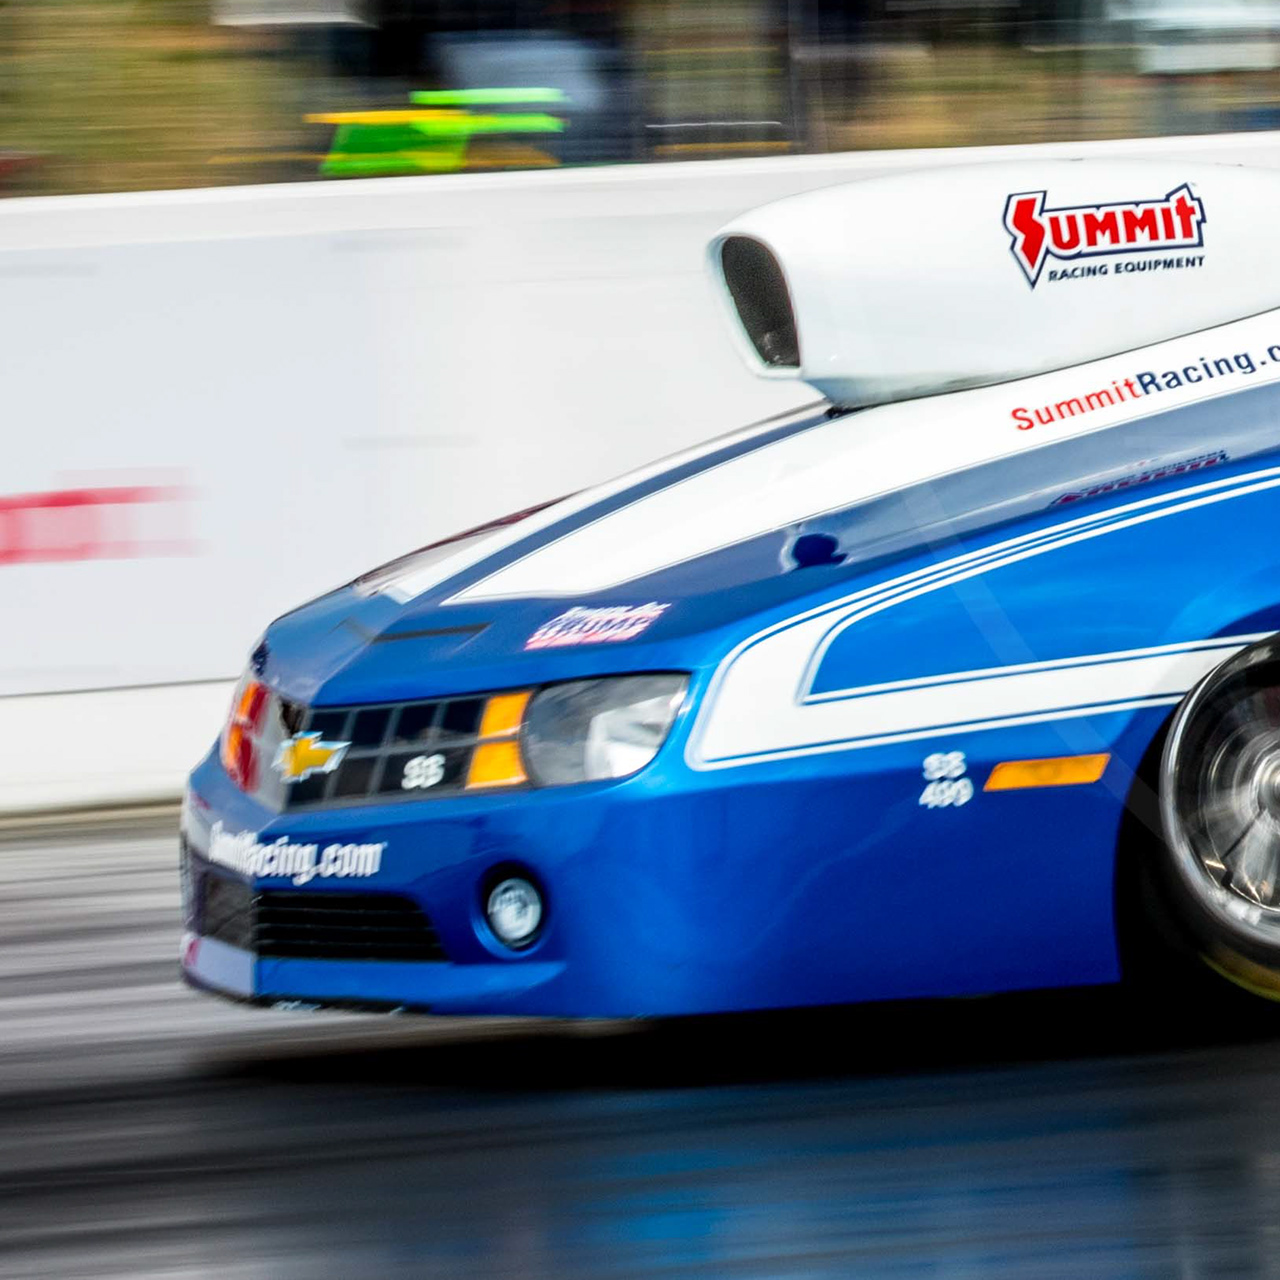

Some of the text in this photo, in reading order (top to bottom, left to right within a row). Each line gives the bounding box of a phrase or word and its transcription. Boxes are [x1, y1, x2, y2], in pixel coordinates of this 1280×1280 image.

[1047, 255, 1206, 283] RACING EQUIPMENT
[402, 753, 446, 790] SS
